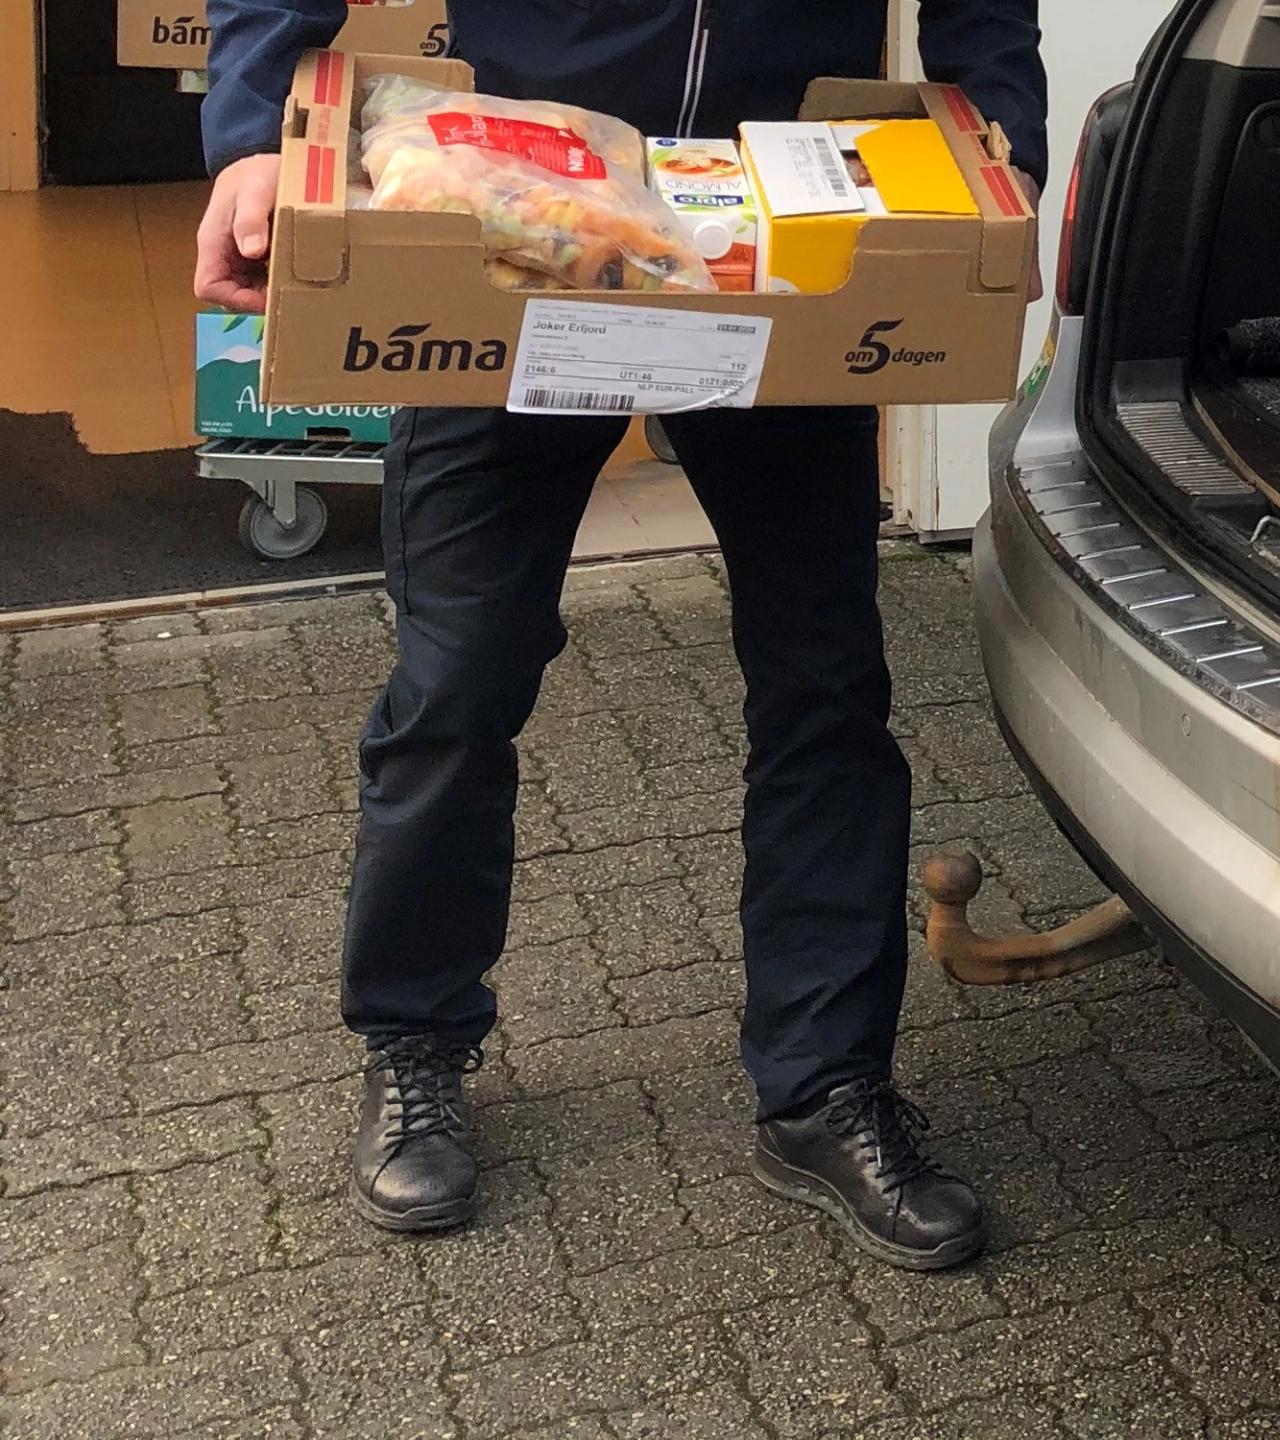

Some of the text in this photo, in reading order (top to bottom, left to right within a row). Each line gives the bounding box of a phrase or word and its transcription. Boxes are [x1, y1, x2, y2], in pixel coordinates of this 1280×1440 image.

[679, 195, 738, 207] alpro
[533, 320, 565, 331] Joker
[845, 317, 946, 374] om 5 dagen
